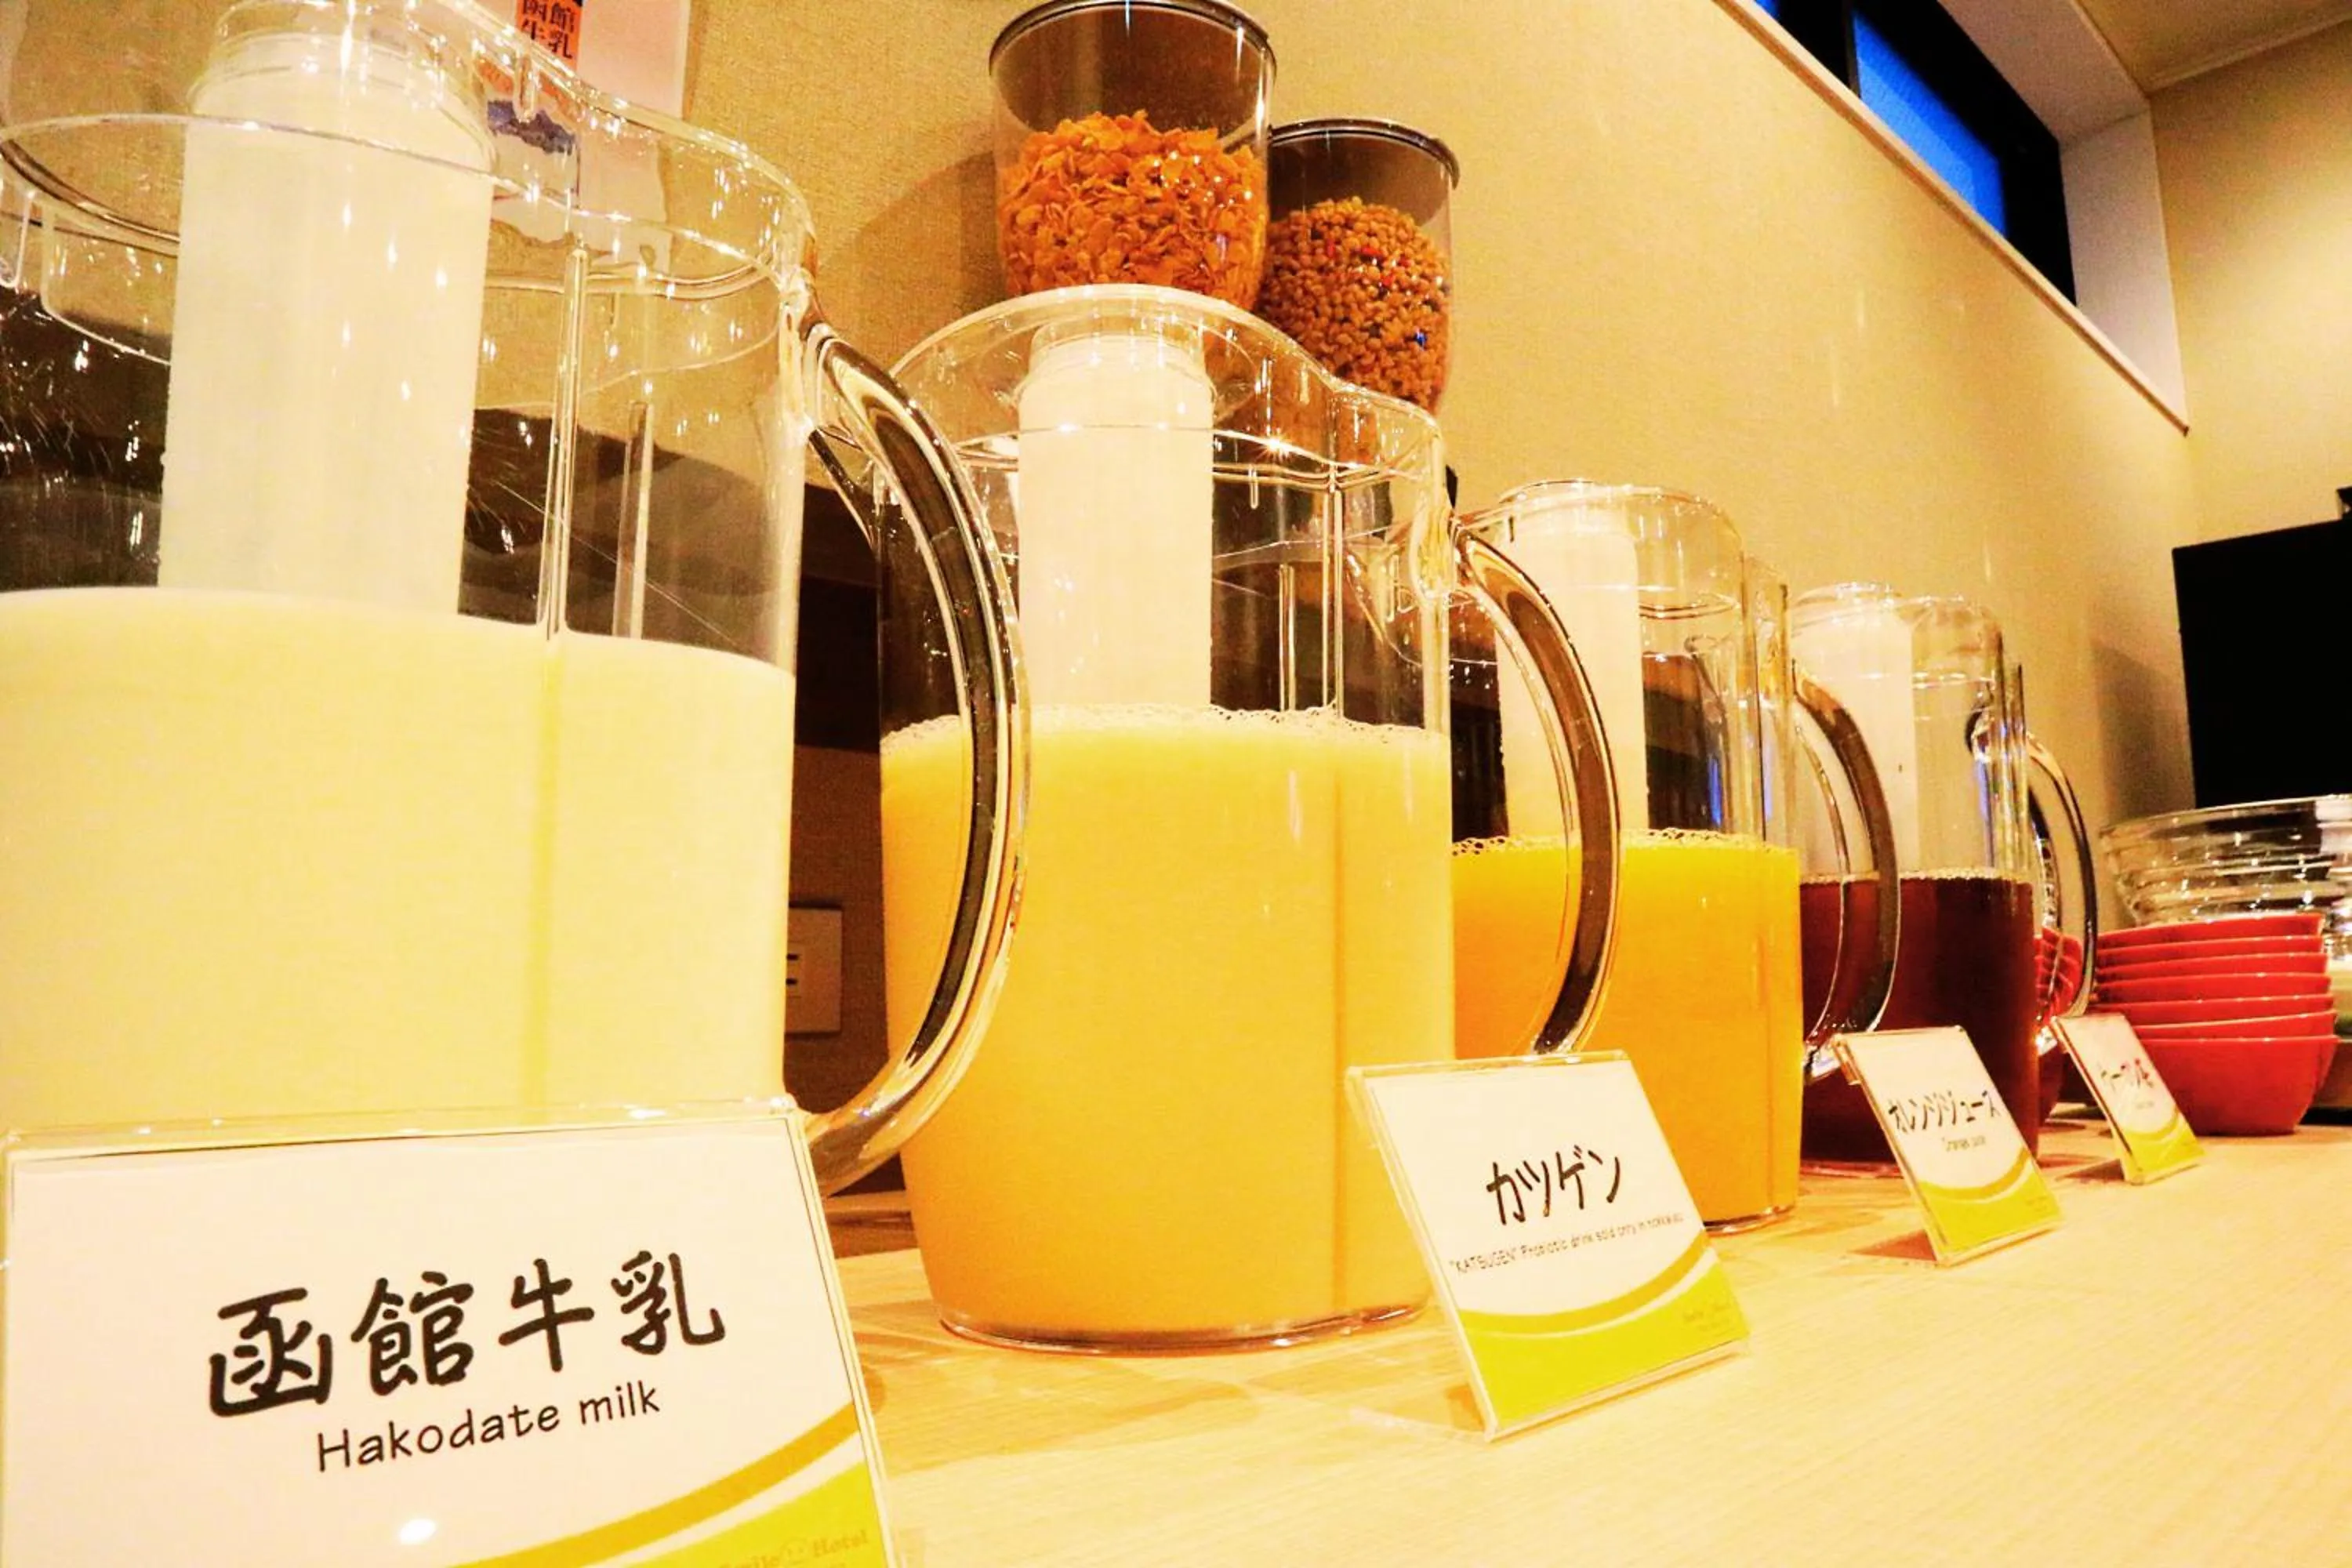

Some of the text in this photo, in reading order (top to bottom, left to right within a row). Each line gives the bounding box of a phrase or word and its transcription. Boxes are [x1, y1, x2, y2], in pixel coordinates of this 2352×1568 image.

[1486, 1145, 1621, 1225] カツゲン
[209, 1250, 726, 1417] 函館牛乳
[318, 1380, 661, 1472] Hakodate milk
